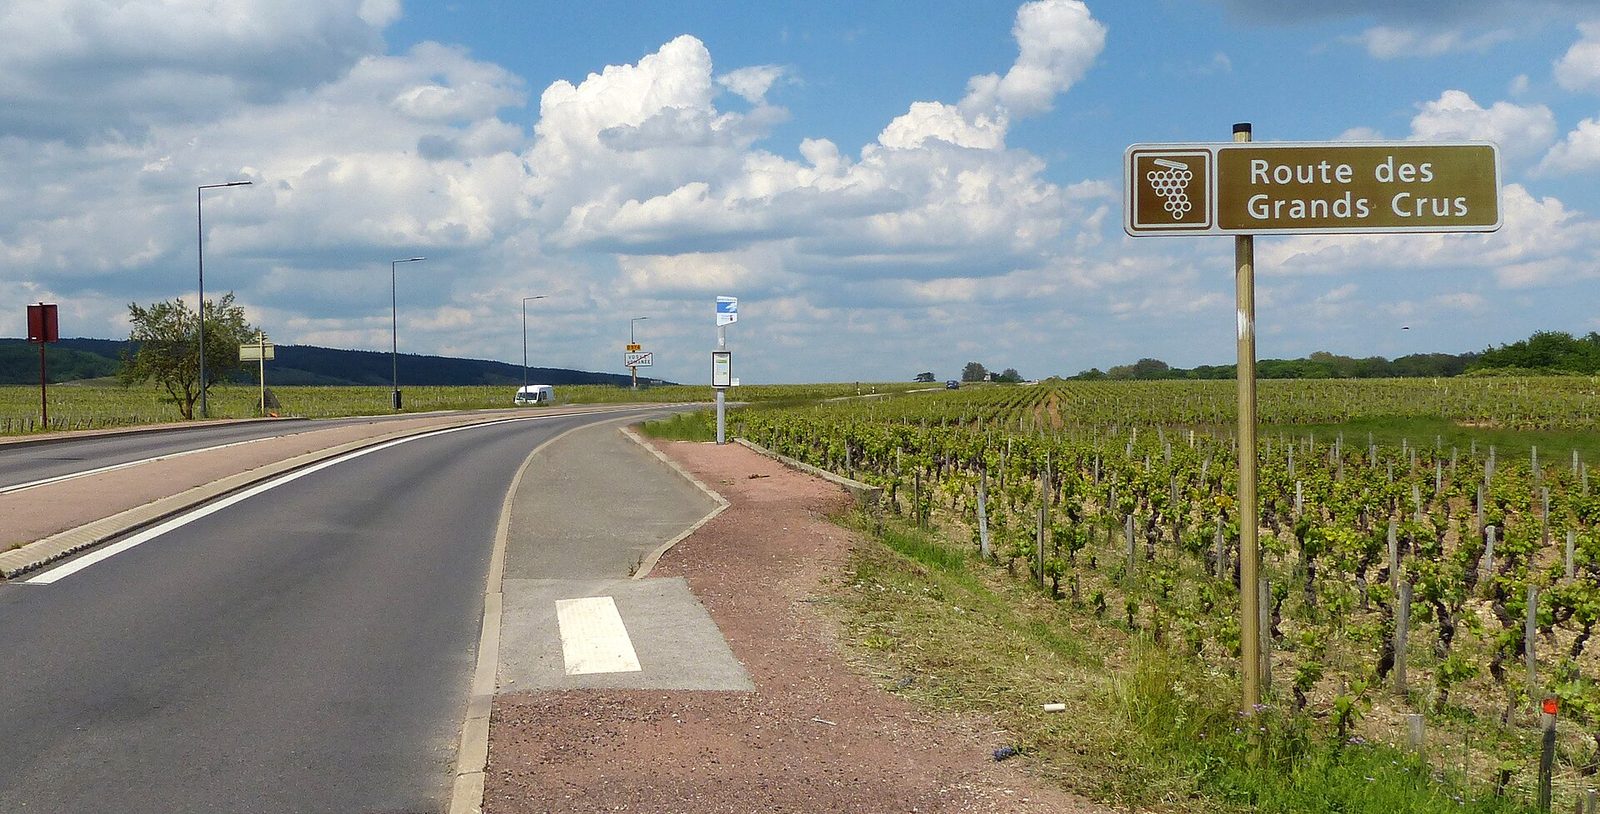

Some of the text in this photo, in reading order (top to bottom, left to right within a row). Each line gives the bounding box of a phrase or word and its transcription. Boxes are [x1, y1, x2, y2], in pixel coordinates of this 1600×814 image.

[1250, 156, 1434, 185] Route des
[1247, 192, 1468, 220] Grands Crus
